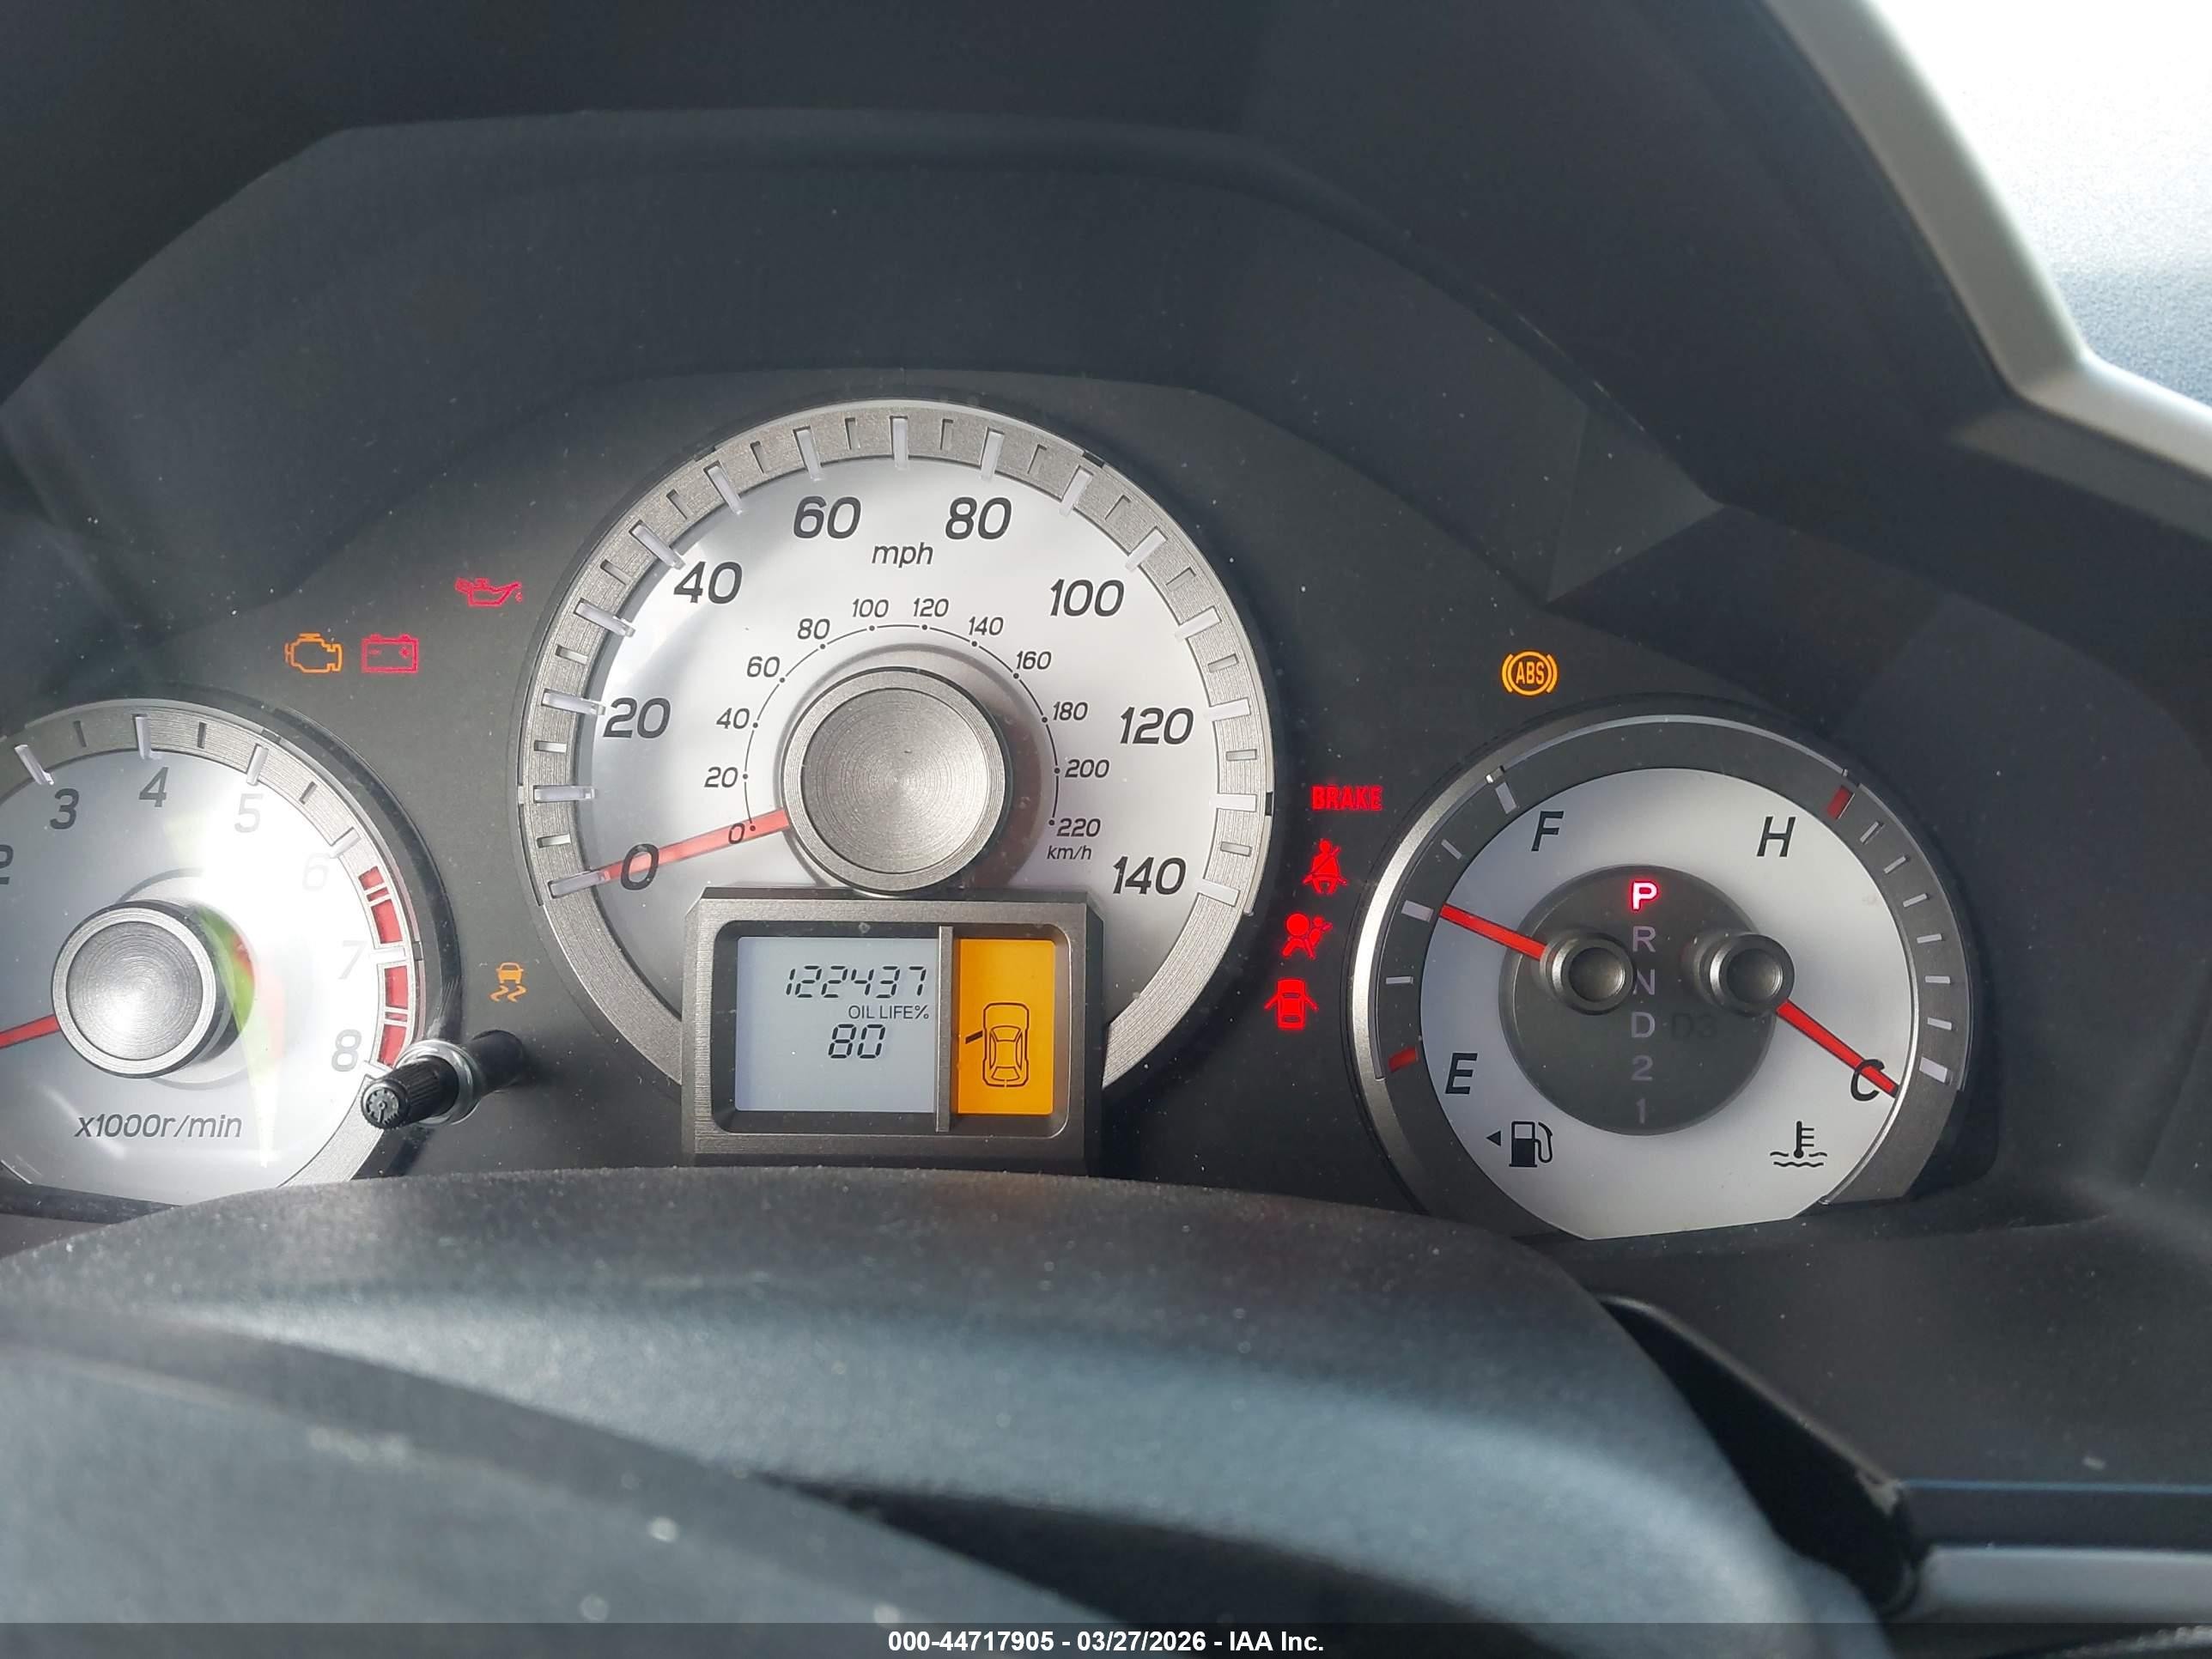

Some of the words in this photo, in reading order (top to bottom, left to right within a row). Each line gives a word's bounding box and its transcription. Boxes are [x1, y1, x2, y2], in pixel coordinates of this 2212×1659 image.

[793, 496, 860, 538] 60
[945, 497, 1012, 539] 80
[872, 542, 933, 568] mph
[673, 560, 742, 604] 40
[853, 599, 889, 617] 100
[914, 599, 949, 617] 120
[1051, 579, 1124, 617] 100
[798, 618, 830, 640] 80
[969, 617, 1003, 635] 140
[747, 657, 780, 678] 60
[1017, 651, 1051, 670] 160
[1516, 661, 1545, 685] ABS
[604, 698, 671, 738] 20
[716, 708, 750, 729] 40
[1054, 702, 1088, 720] 180
[1121, 707, 1194, 744] 120
[704, 767, 738, 787] 20
[1065, 759, 1109, 778] 200
[140, 767, 168, 807] 4
[1312, 785, 1382, 811] BRAKE
[50, 788, 79, 830] 3
[234, 793, 263, 833] 5
[727, 823, 745, 844] 0
[1056, 818, 1100, 836] 220
[1531, 811, 1564, 852] F
[1757, 817, 1796, 857] H
[1047, 845, 1091, 860] km/h
[302, 853, 330, 891] 6
[620, 843, 659, 891] 0
[1113, 856, 1186, 895] 140
[1632, 882, 1657, 910] P
[1633, 926, 1656, 951] R
[337, 940, 368, 979] 7
[787, 966, 926, 998] 122437
[1633, 969, 1655, 995] N
[848, 1006, 875, 1018] OIL
[880, 1005, 928, 1019] LIFE%
[1632, 1012, 1655, 1037] D
[331, 1030, 362, 1072] 8
[829, 1024, 885, 1059] 80
[1445, 1053, 1477, 1094] E
[1632, 1055, 1653, 1080] 2
[1850, 1058, 1884, 1103] C
[1636, 1097, 1646, 1123] 1
[75, 1114, 242, 1139] x1000r/min
